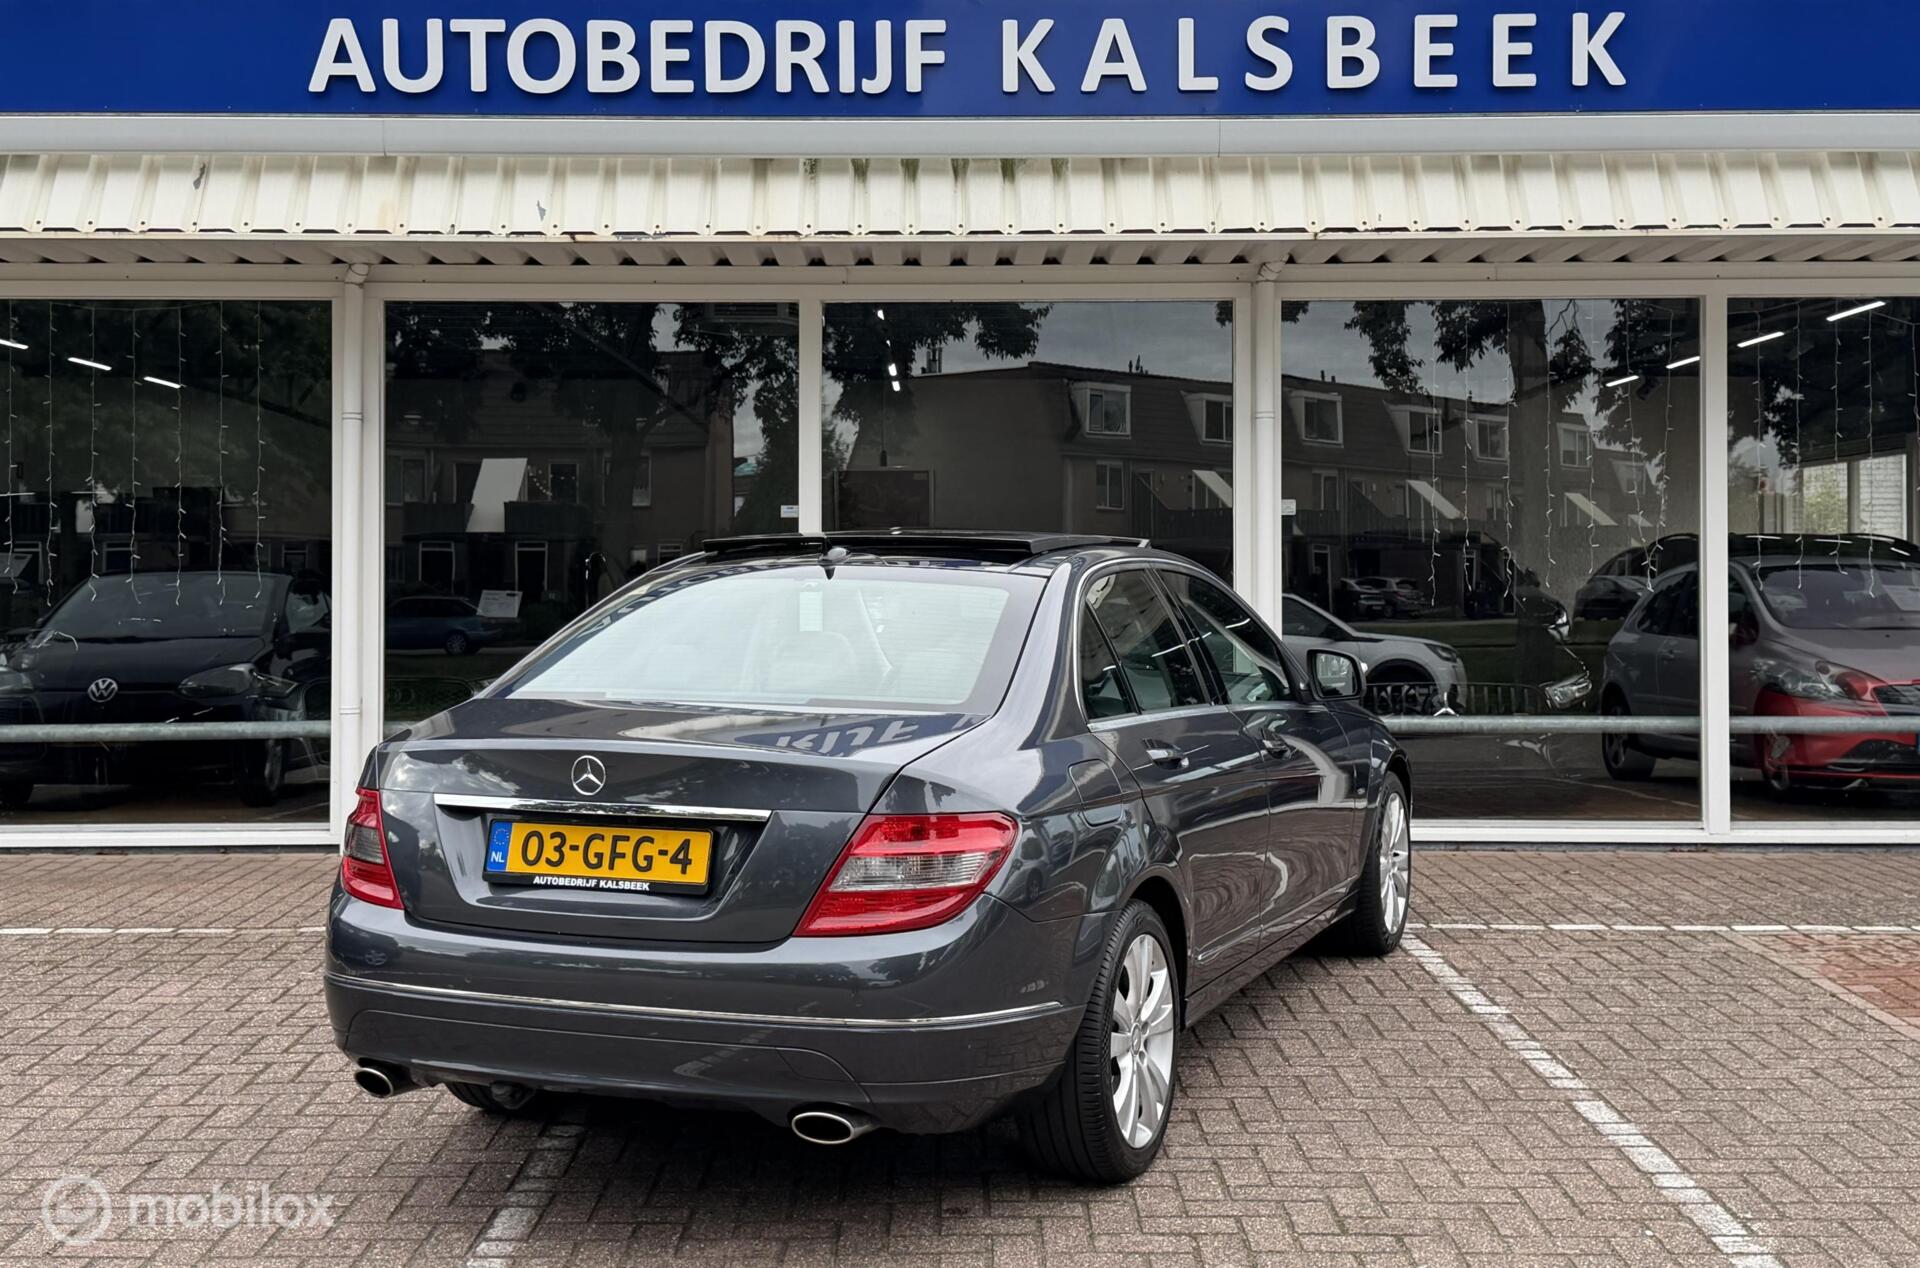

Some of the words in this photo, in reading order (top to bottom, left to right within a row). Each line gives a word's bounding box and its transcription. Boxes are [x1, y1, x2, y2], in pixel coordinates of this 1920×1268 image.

[308, 18, 947, 94] AUTOBEDRIJF
[1002, 12, 1627, 92] KALSBEEK
[490, 851, 505, 863] NL
[521, 830, 692, 875] 03-GFG-4
[533, 875, 598, 888] AUTOBEDRIJF
[599, 879, 650, 891] KALSBEEK
